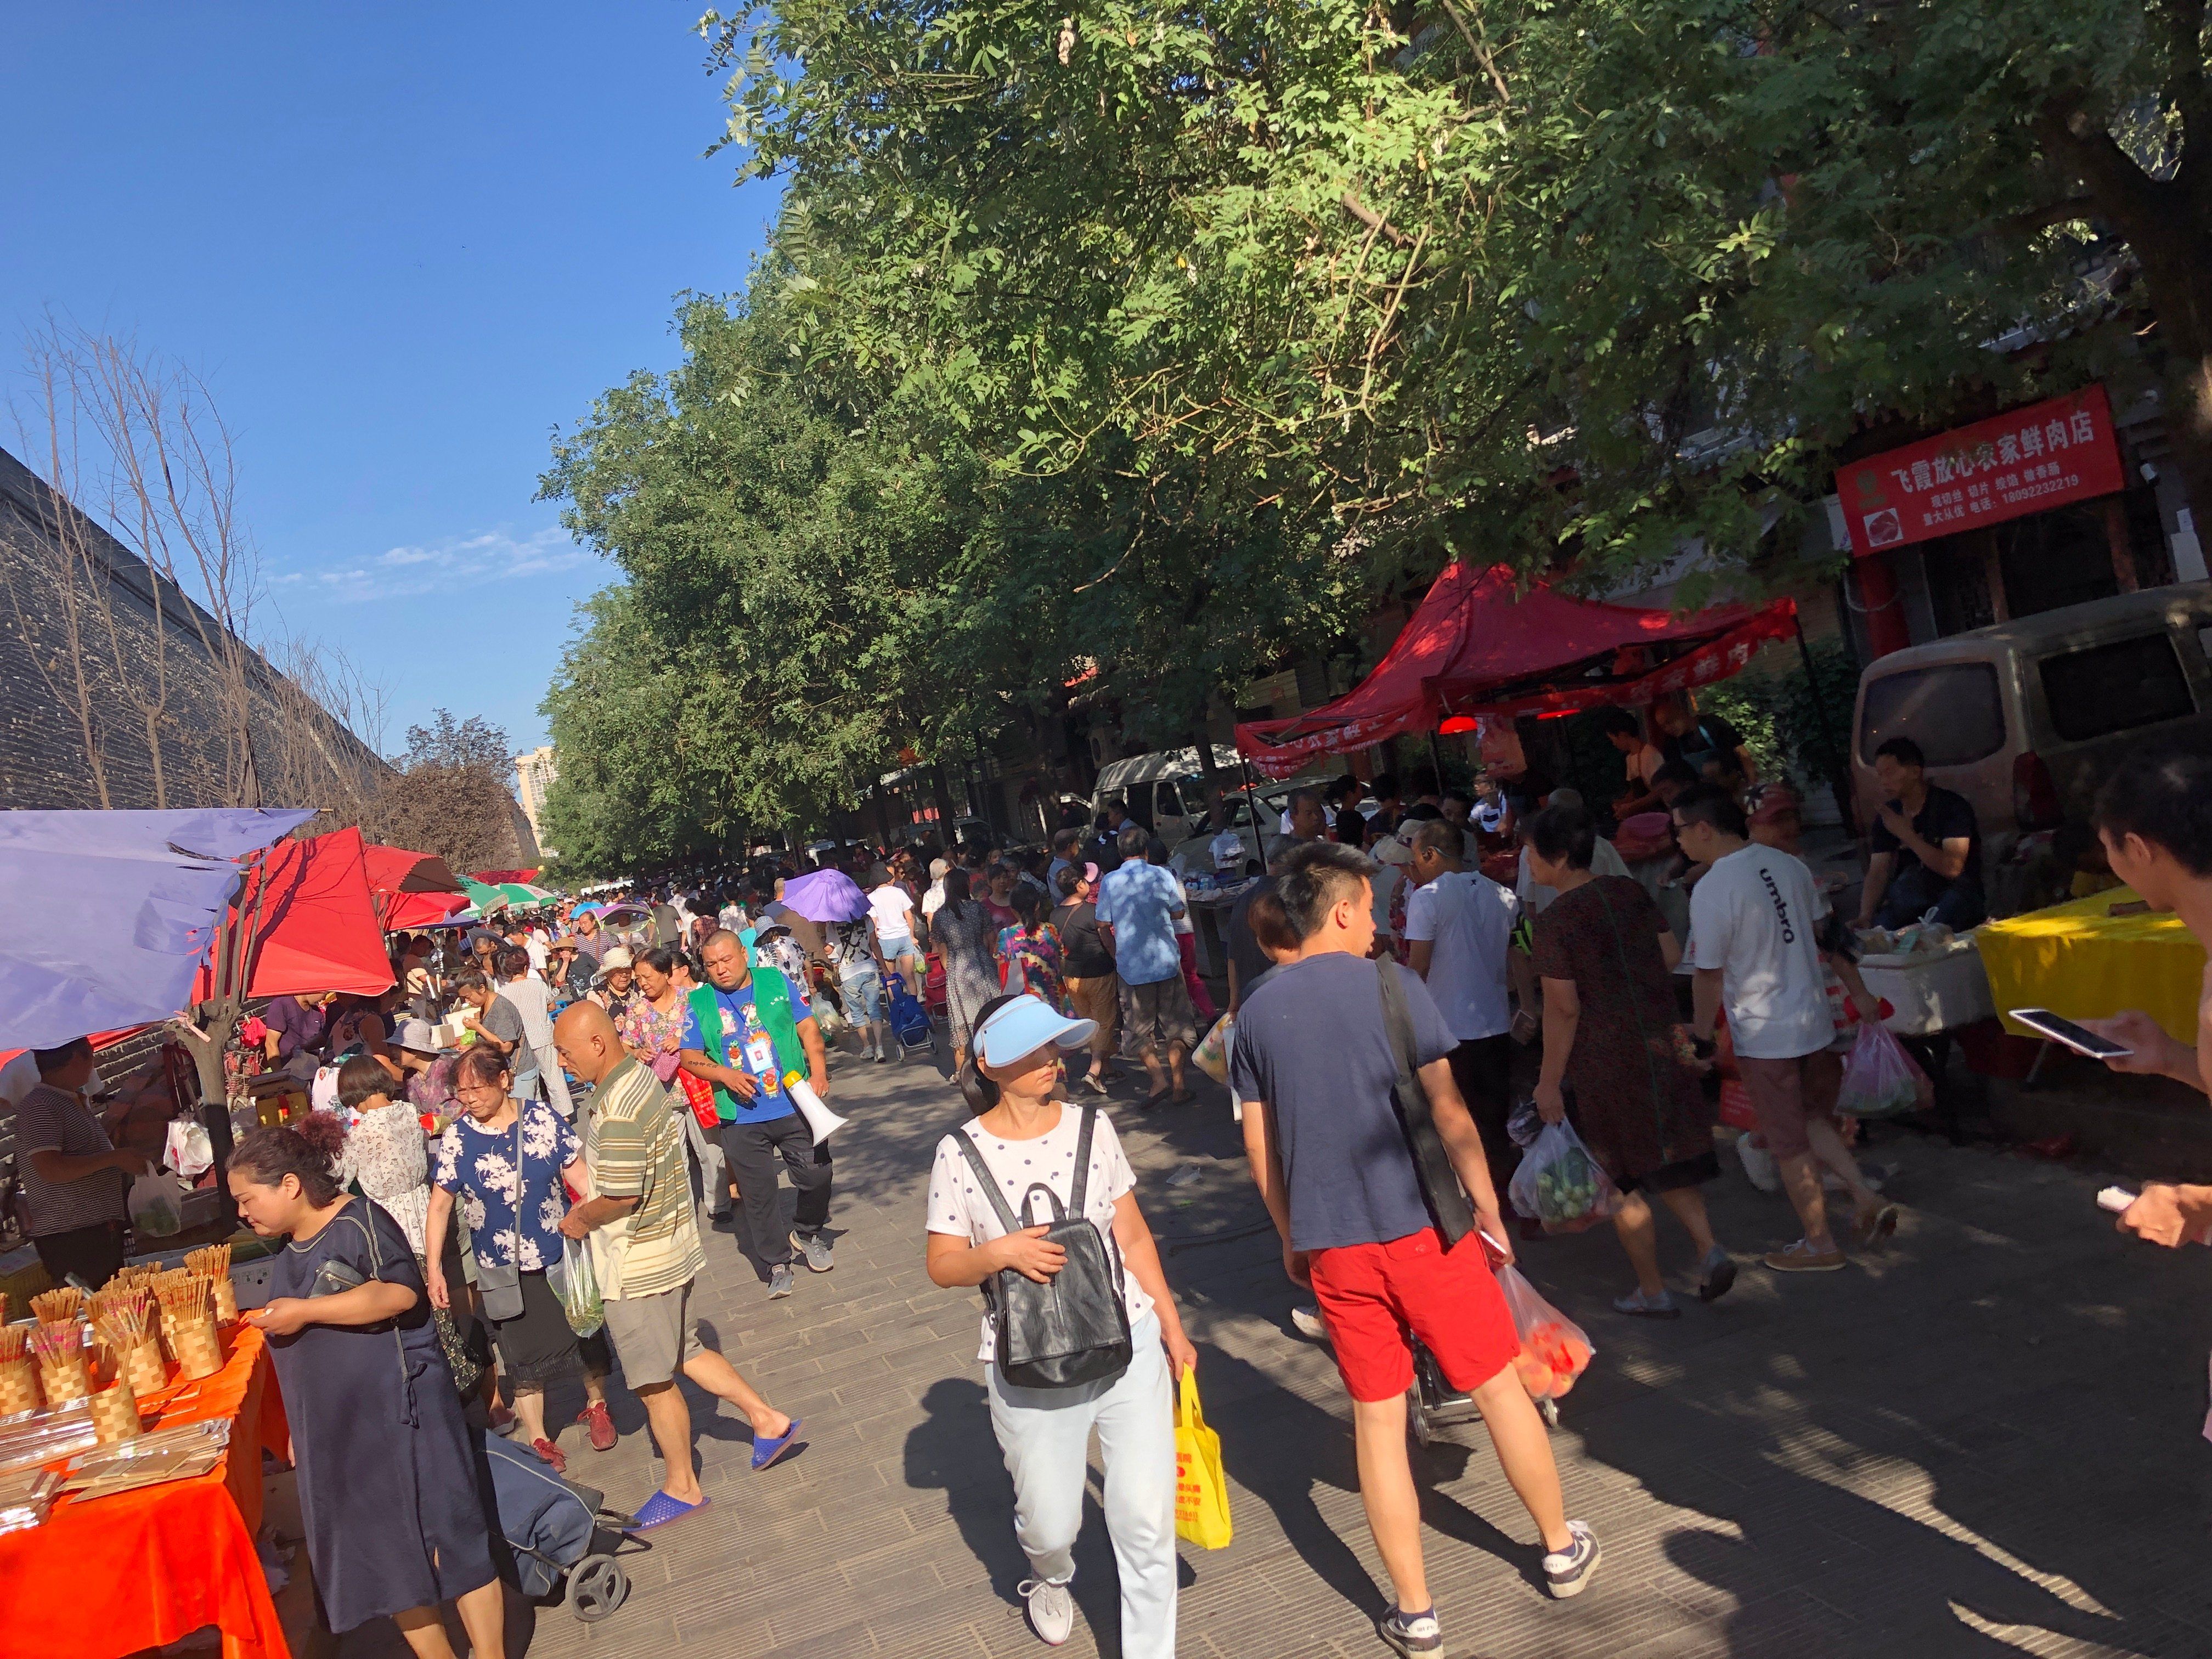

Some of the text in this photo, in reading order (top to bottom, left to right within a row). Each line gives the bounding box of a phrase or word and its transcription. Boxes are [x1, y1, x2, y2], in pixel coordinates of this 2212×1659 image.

[1891, 410, 2095, 494] 飞霞放心农家鲜肉店
[1923, 504, 1966, 527] 量大从优
[2002, 474, 2079, 504] 18092232219
[1759, 868, 1795, 944] umbro
